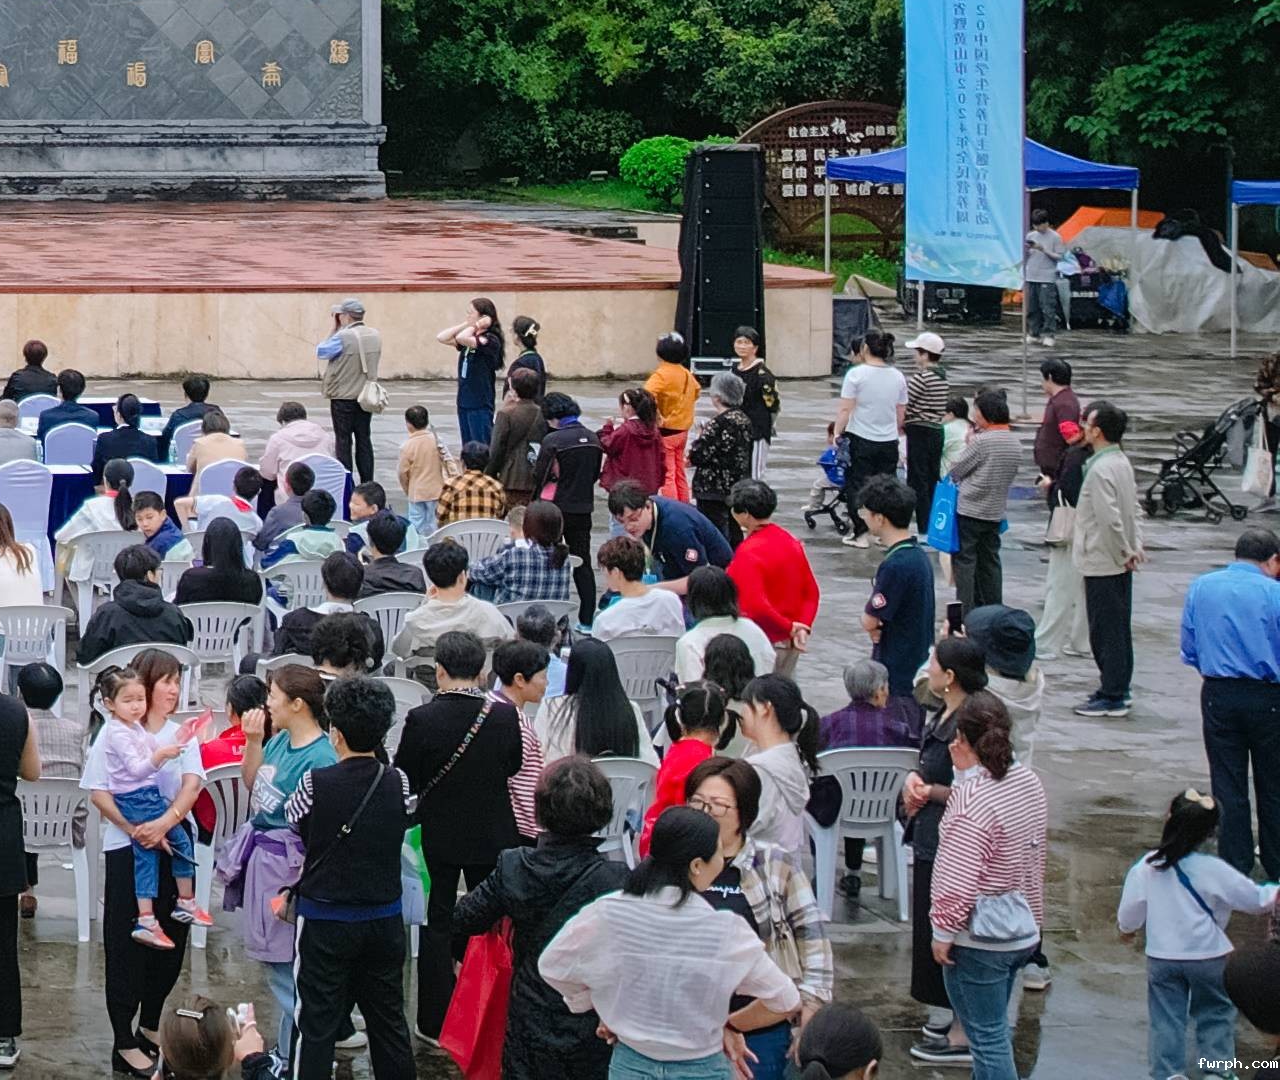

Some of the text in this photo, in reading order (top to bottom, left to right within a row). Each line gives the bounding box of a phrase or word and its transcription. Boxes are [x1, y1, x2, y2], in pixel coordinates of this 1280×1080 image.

[781, 148, 807, 162] 富强
[814, 148, 839, 161] 民主
[781, 166, 807, 179] 自由
[782, 184, 807, 197] 爱国
[845, 182, 873, 197] 诚信
